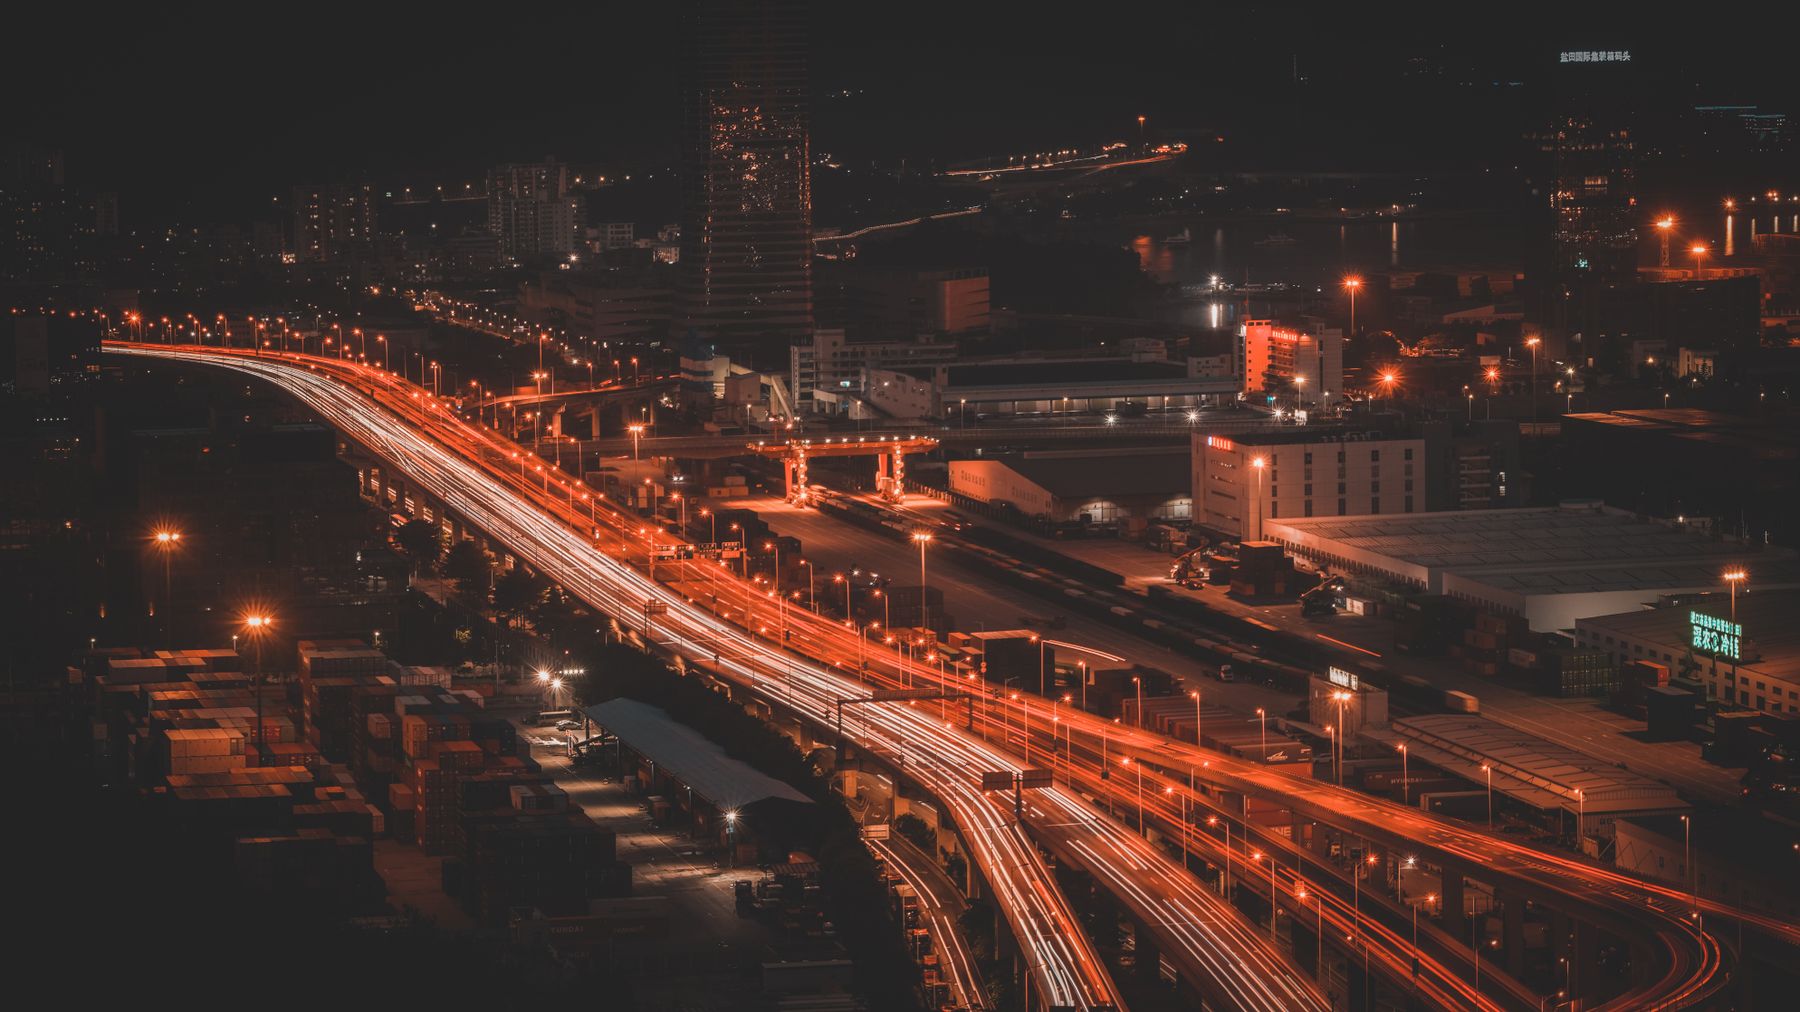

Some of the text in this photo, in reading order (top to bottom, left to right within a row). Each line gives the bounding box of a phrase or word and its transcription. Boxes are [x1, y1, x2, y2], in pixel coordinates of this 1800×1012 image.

[1560, 51, 1631, 63] 盐田国际集装箱码头
